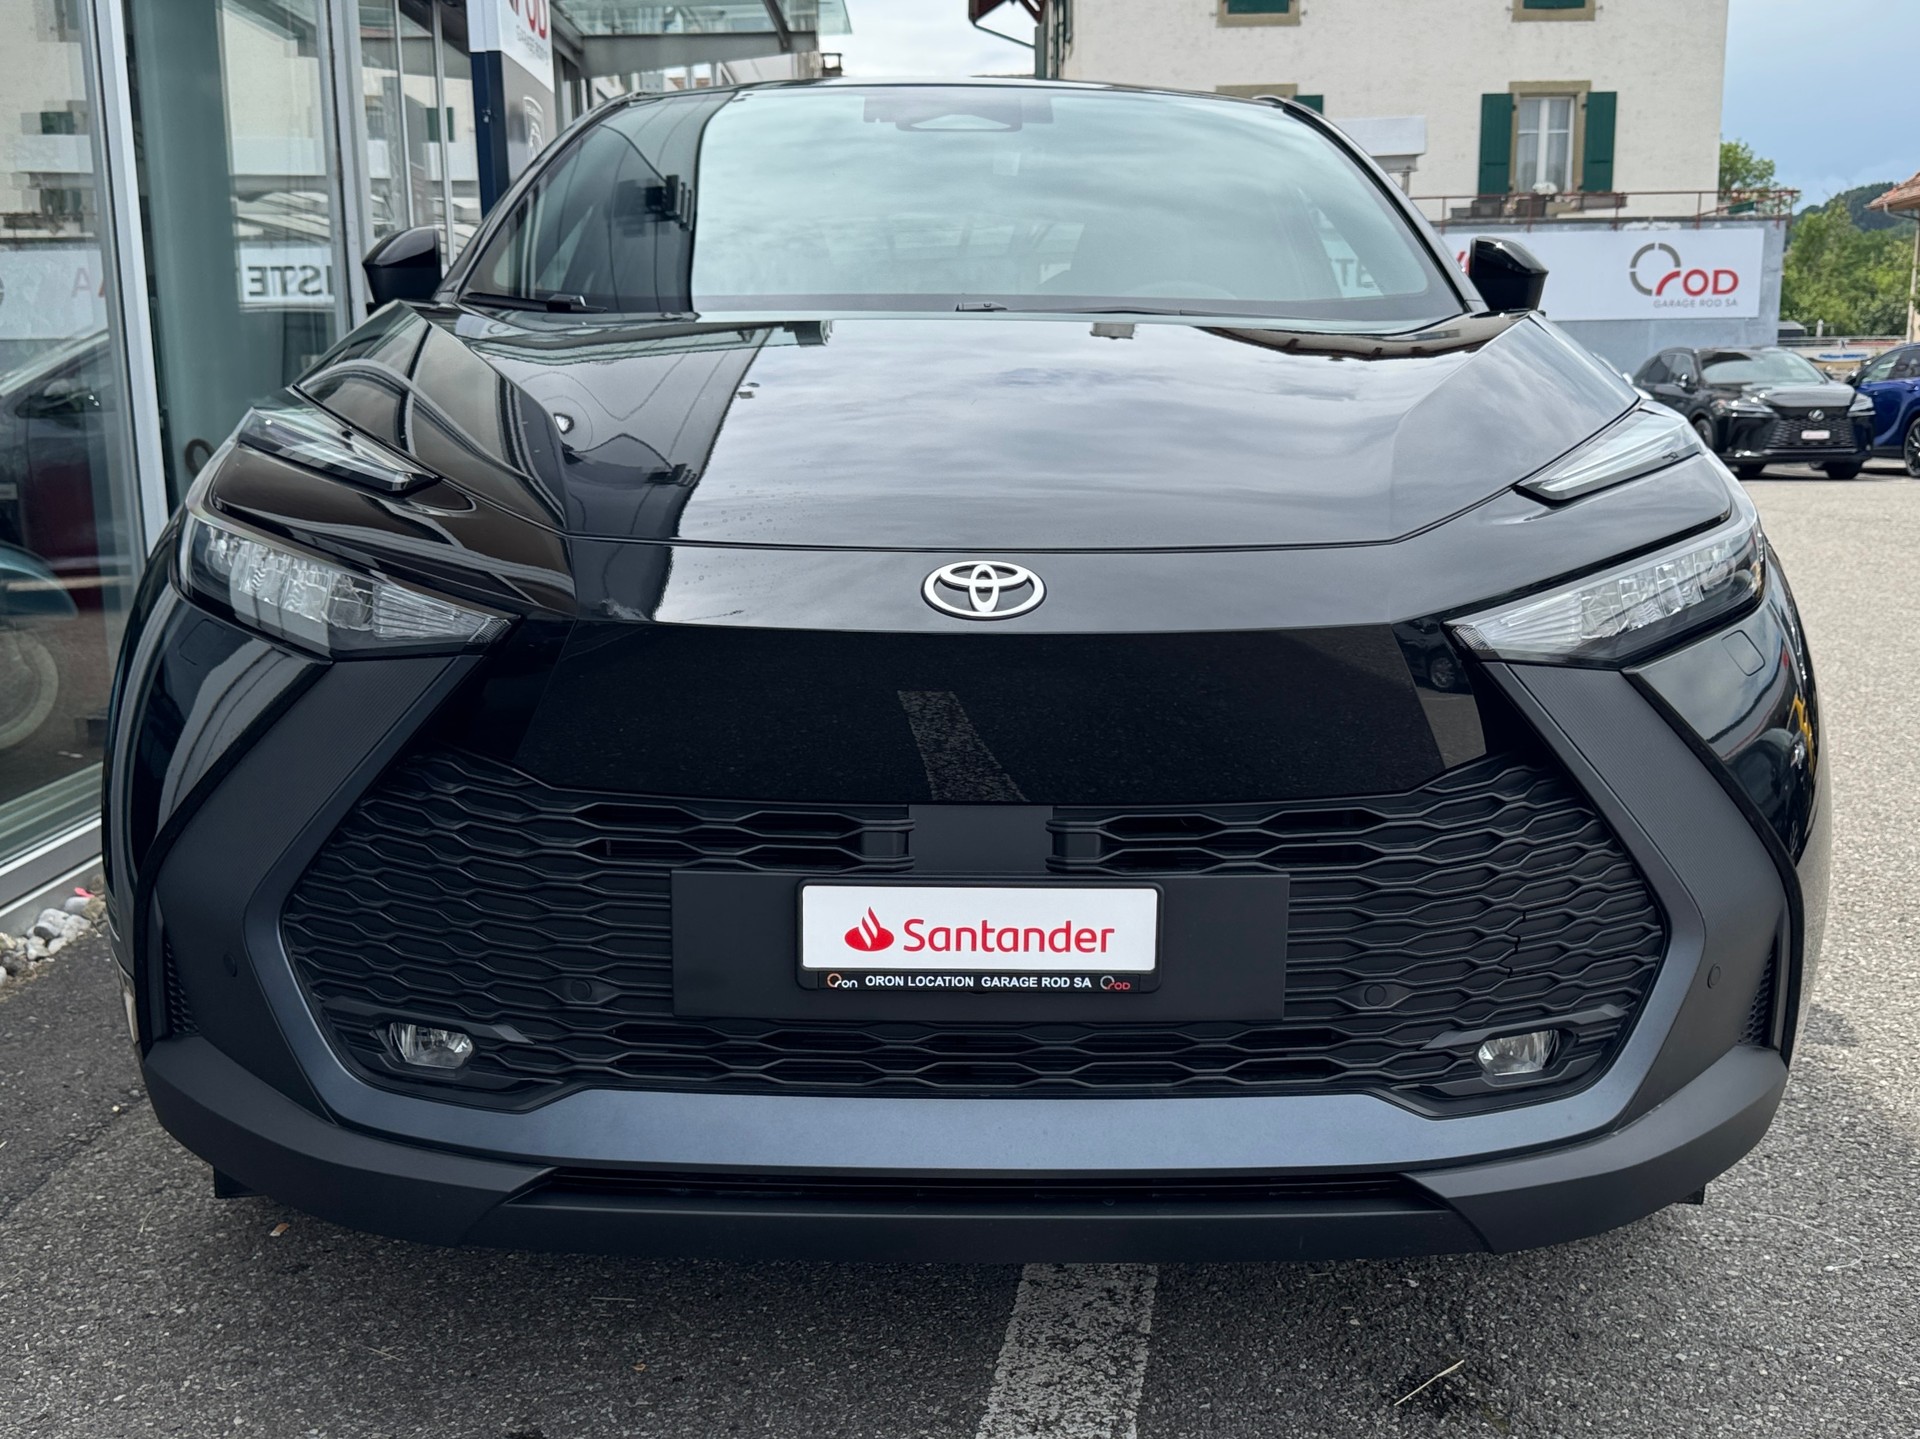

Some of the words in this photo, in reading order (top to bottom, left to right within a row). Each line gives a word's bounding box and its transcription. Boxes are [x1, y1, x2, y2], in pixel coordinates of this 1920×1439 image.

[1653, 299, 1696, 309] GARAGE
[1699, 298, 1722, 308] ROD
[1725, 298, 1739, 308] SA
[902, 918, 1115, 953] Santander
[865, 975, 904, 987] ORON
[907, 975, 974, 988] LOCATION
[981, 976, 1038, 988] GARAGE
[1041, 977, 1070, 988] ROD
[1073, 977, 1092, 988] SA
